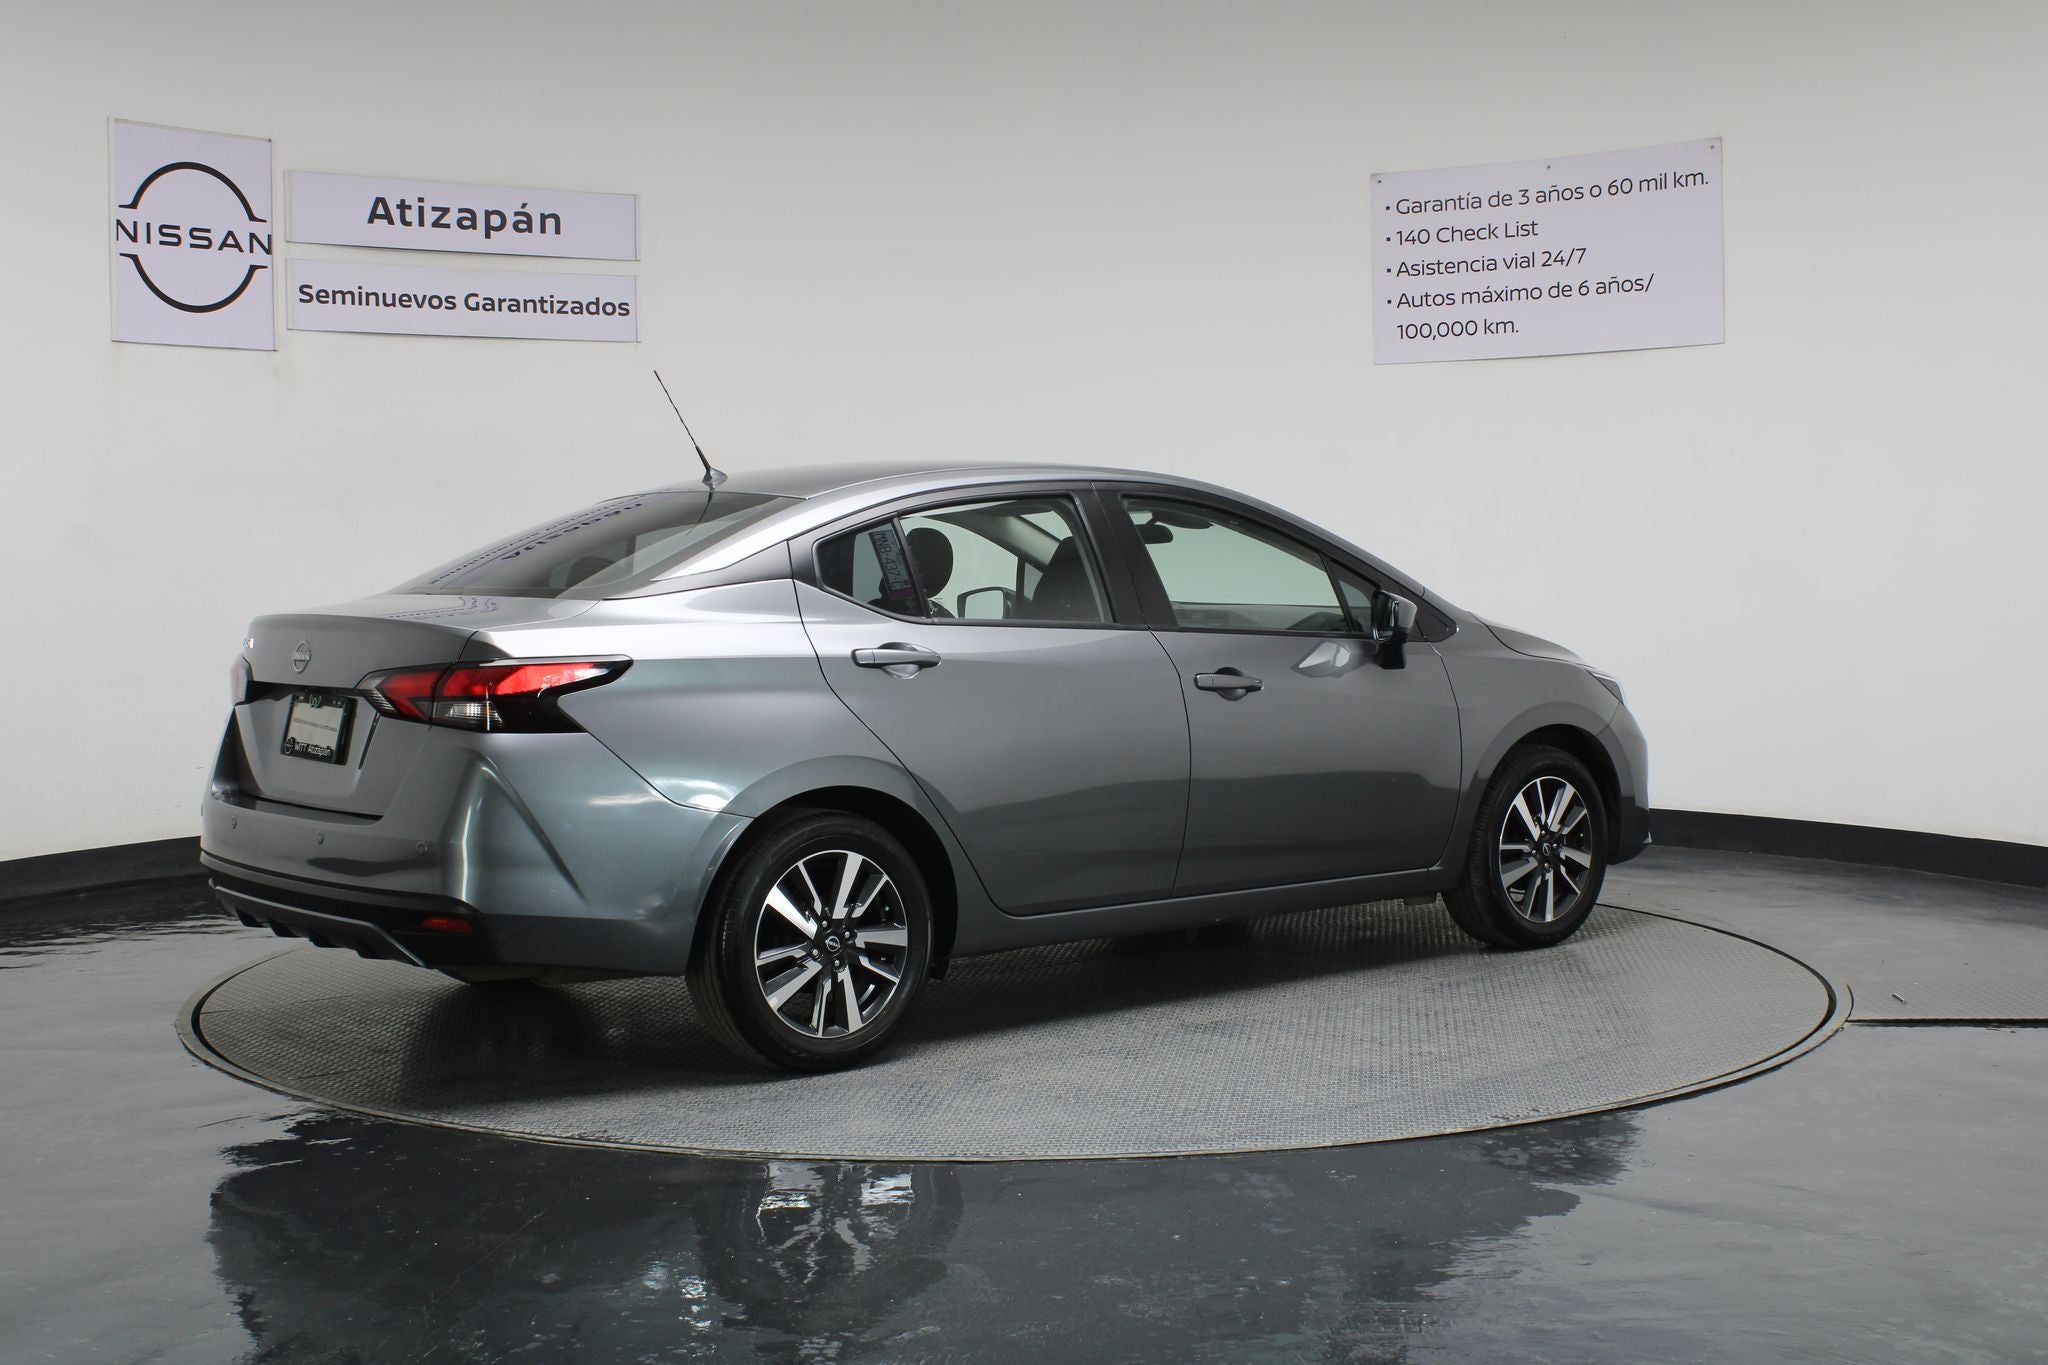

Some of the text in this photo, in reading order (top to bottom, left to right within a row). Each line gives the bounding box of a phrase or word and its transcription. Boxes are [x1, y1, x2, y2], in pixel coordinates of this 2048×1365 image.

[1395, 171, 1709, 215] Garantía de 3 años o 60 mil km.
[367, 196, 561, 240] Atizapán
[1396, 220, 1539, 246] 140 Check List
[115, 218, 273, 256] NISSAN
[1396, 247, 1587, 278] Asistencia vial 24/7
[298, 284, 631, 317] Seminuevos Garantizados
[1396, 272, 1655, 309] Autos máximo de 6 años/
[1396, 318, 1519, 341] 100,000 km.
